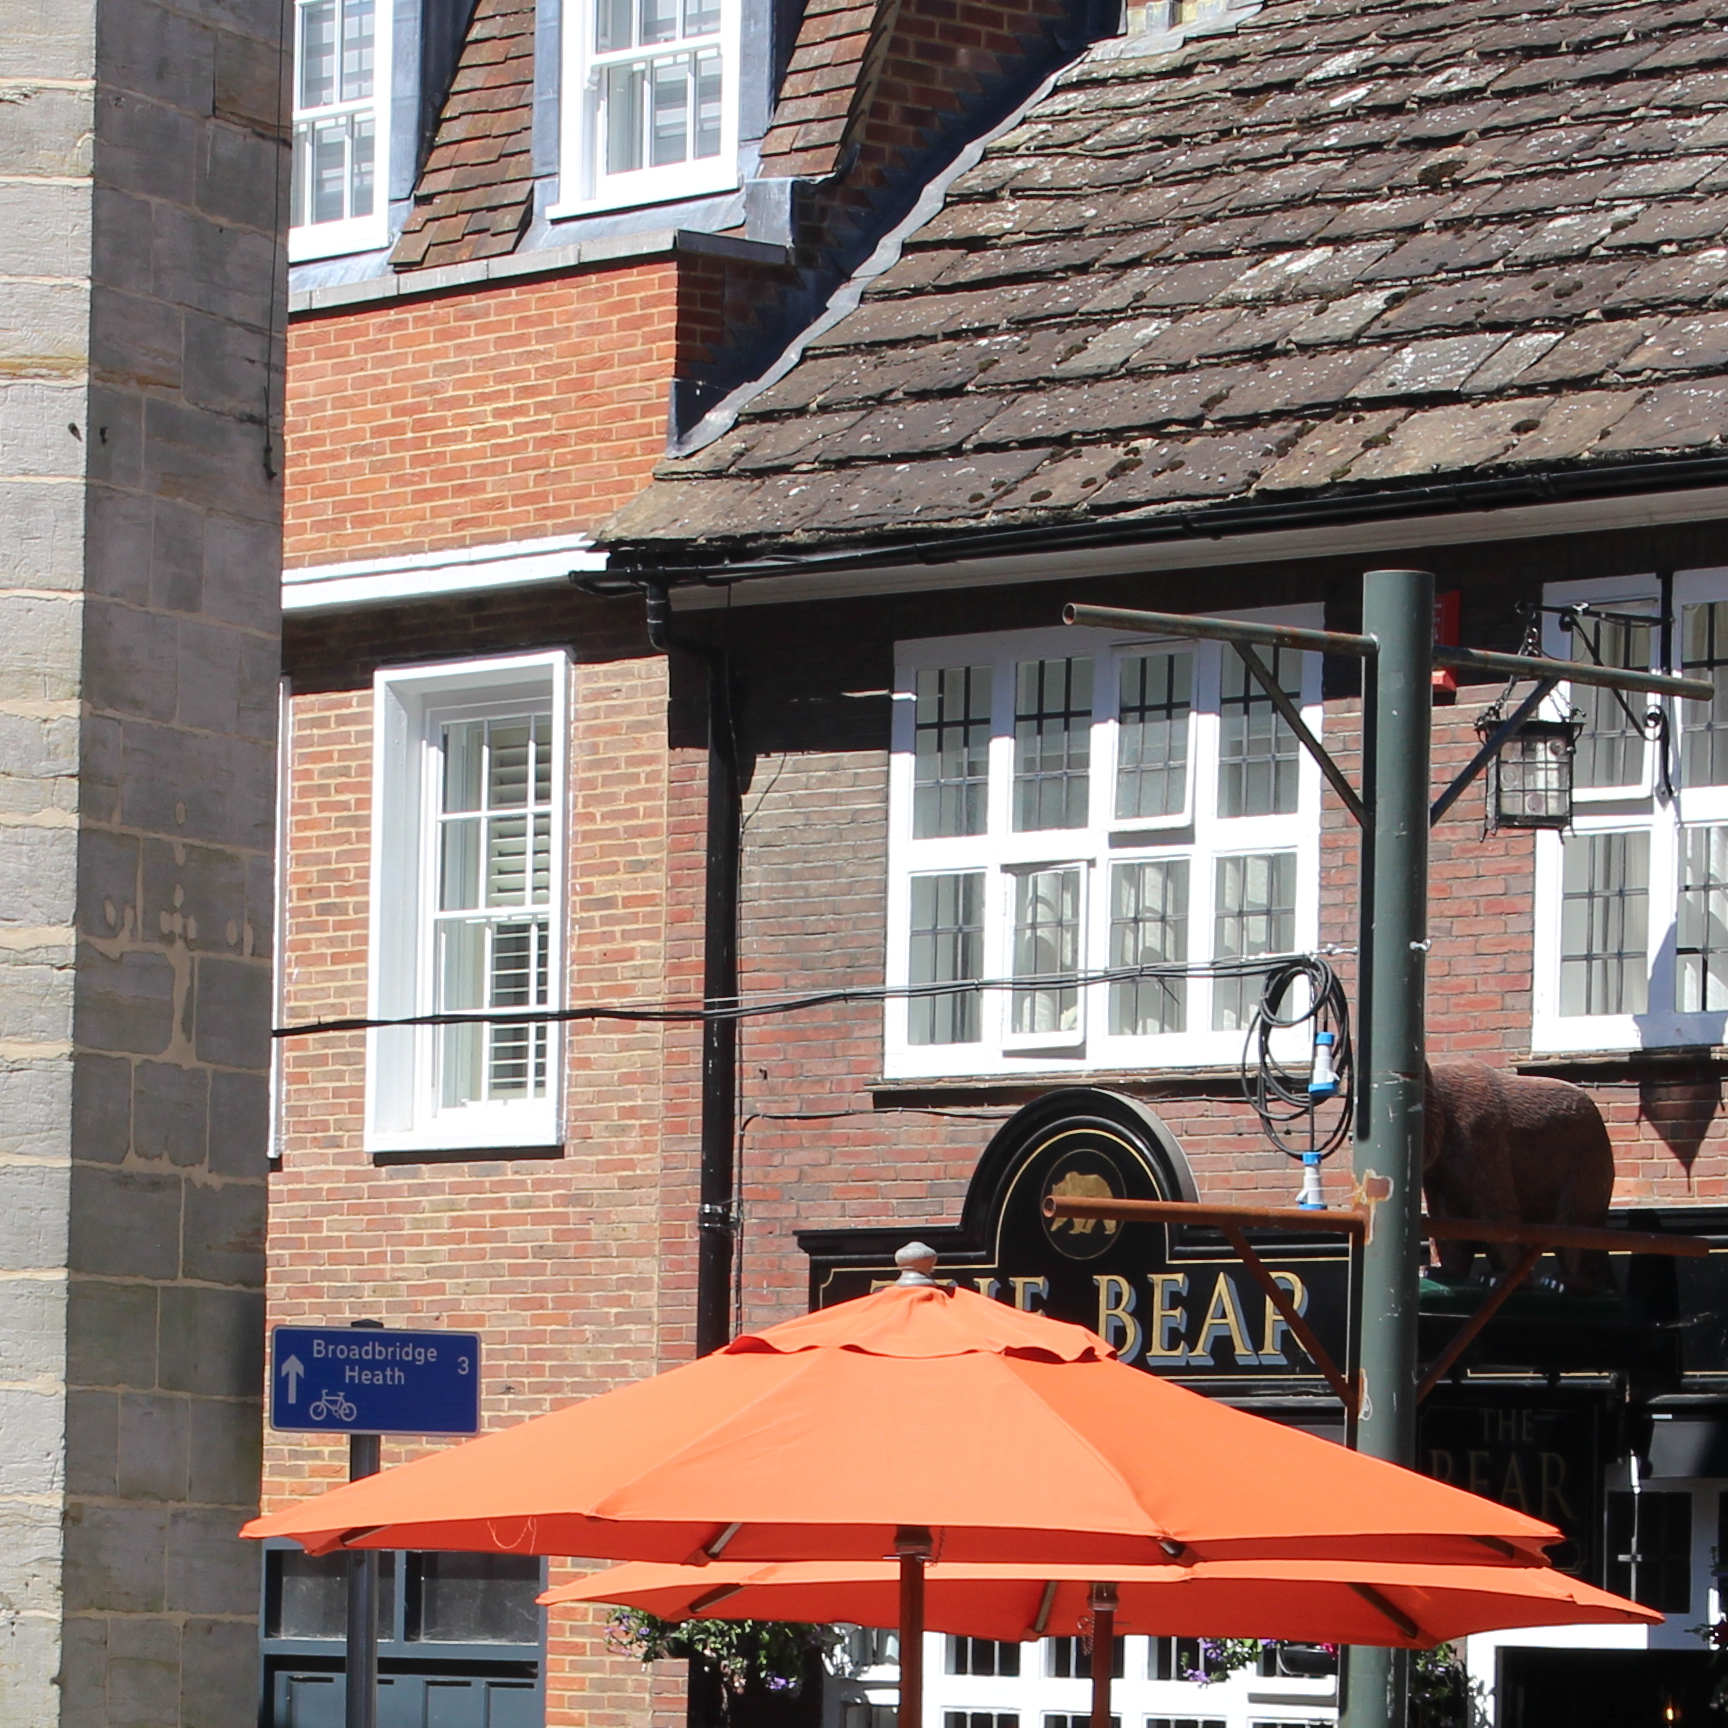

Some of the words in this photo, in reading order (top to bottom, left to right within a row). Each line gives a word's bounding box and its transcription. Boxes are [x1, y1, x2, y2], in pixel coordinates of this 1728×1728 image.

[1092, 1270, 1314, 1366] BEAR
[313, 1339, 438, 1365] Broadbridge
[344, 1365, 405, 1385] Heath
[457, 1356, 469, 1375] 3
[1478, 1408, 1534, 1441] THE
